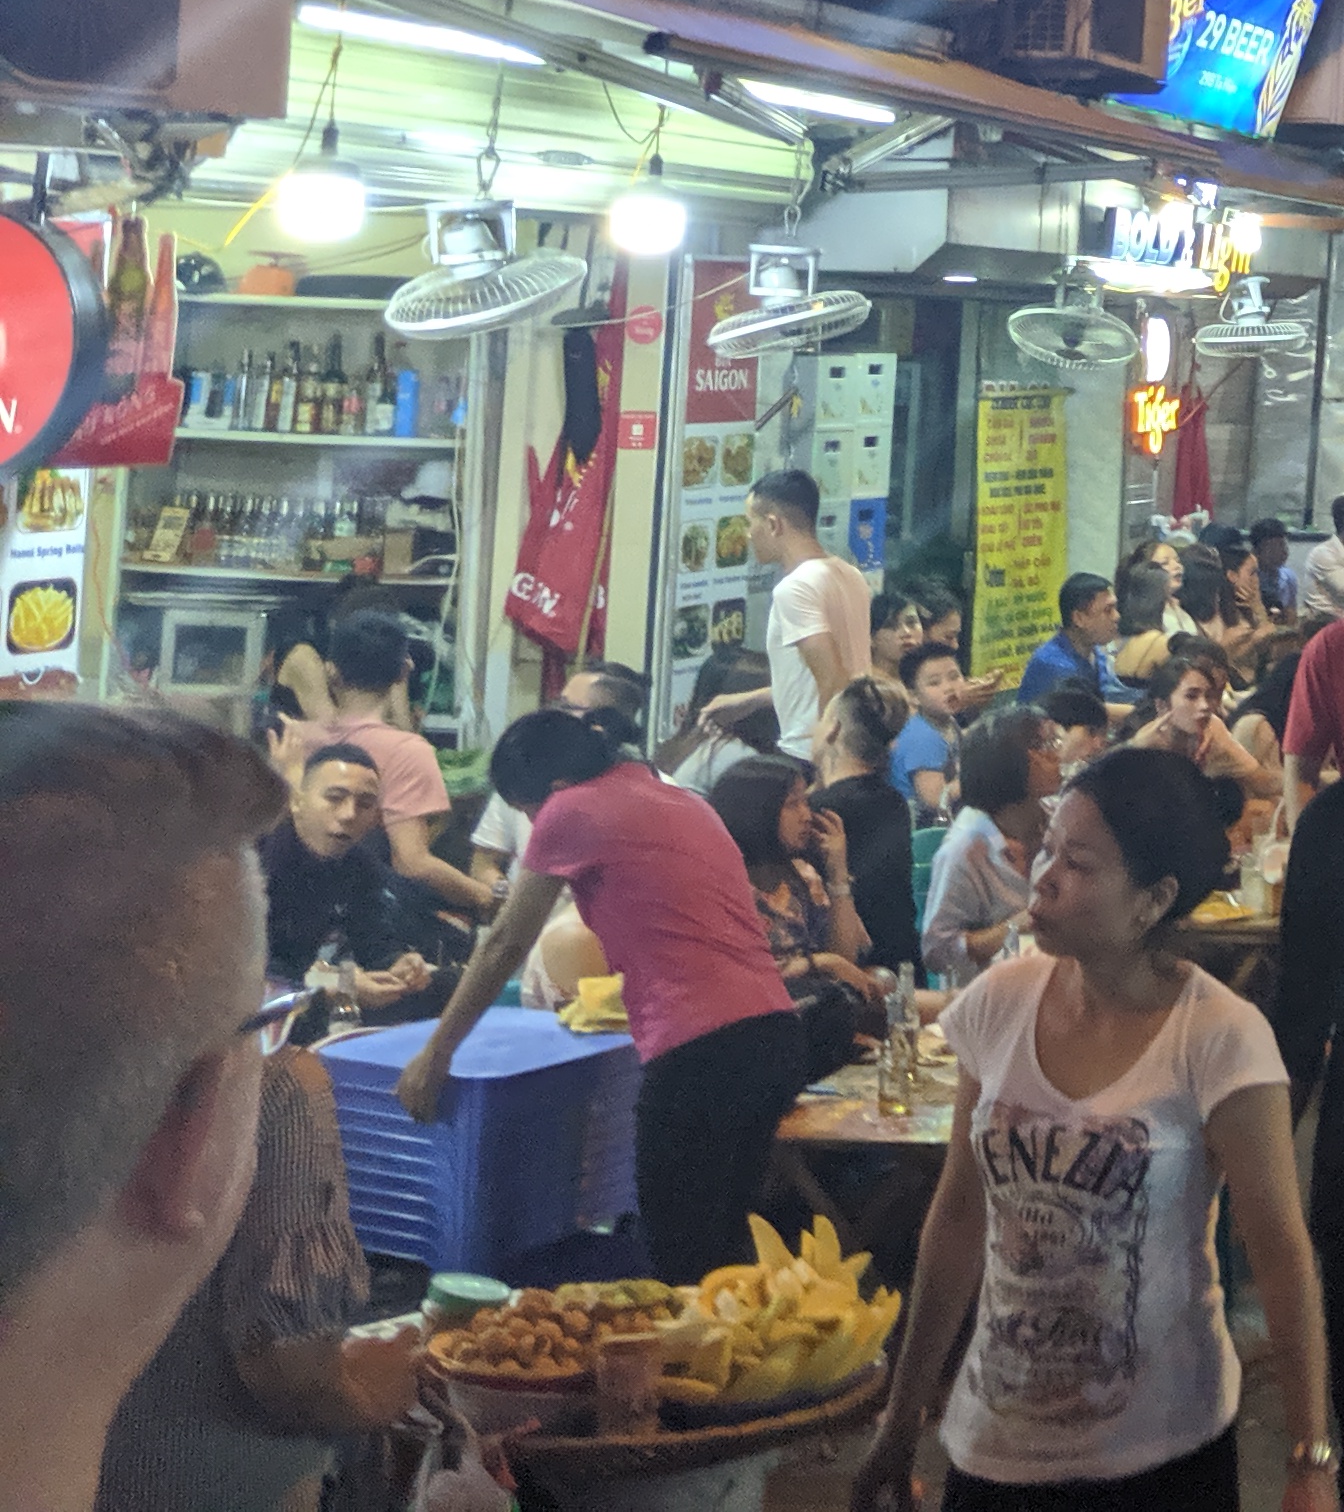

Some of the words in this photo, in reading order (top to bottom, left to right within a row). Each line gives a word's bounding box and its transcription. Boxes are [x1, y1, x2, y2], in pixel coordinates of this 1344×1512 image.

[1195, 10, 1226, 50] 29
[1221, 18, 1275, 65] BEER
[695, 369, 748, 392] SAIGON
[1134, 385, 1180, 454] Tiger
